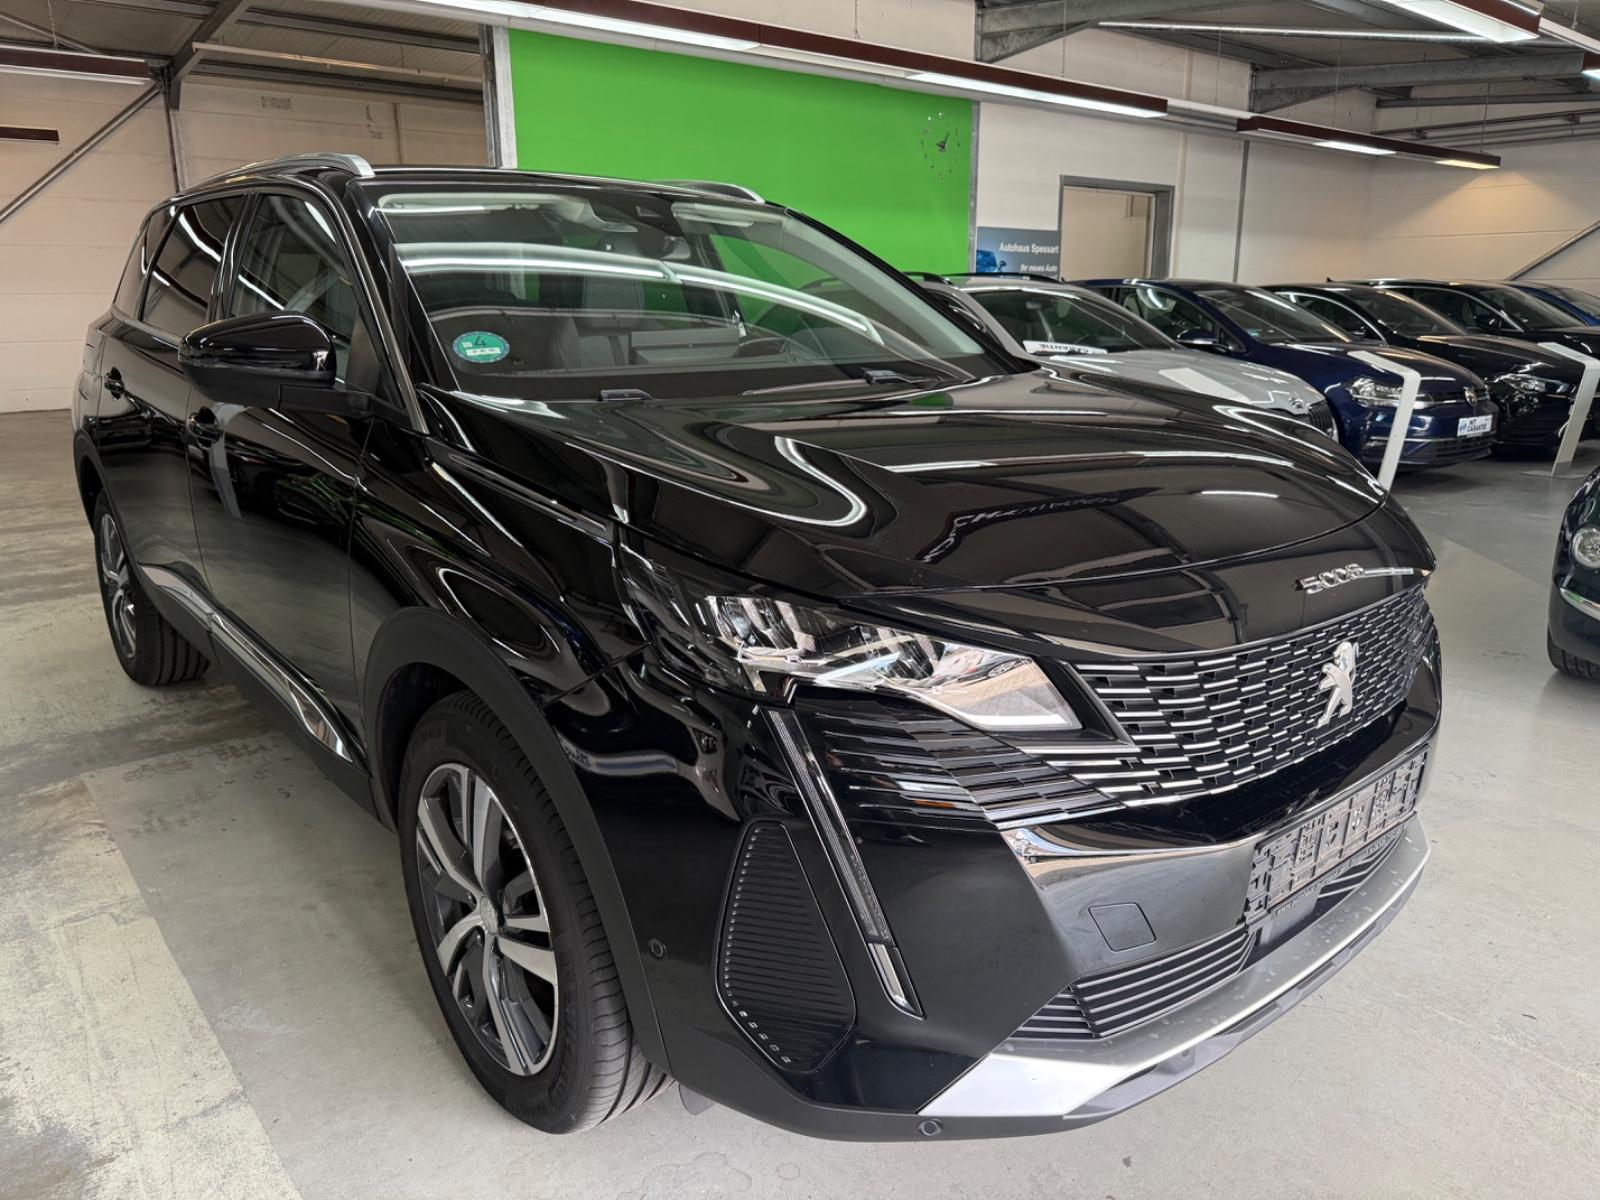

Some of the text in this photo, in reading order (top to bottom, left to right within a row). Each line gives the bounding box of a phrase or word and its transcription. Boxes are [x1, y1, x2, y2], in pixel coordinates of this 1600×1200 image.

[999, 242, 1059, 254] Autohaus Spessart
[1045, 264, 1058, 272] Auto
[474, 336, 486, 347] 4
[1300, 563, 1364, 594] 5008
